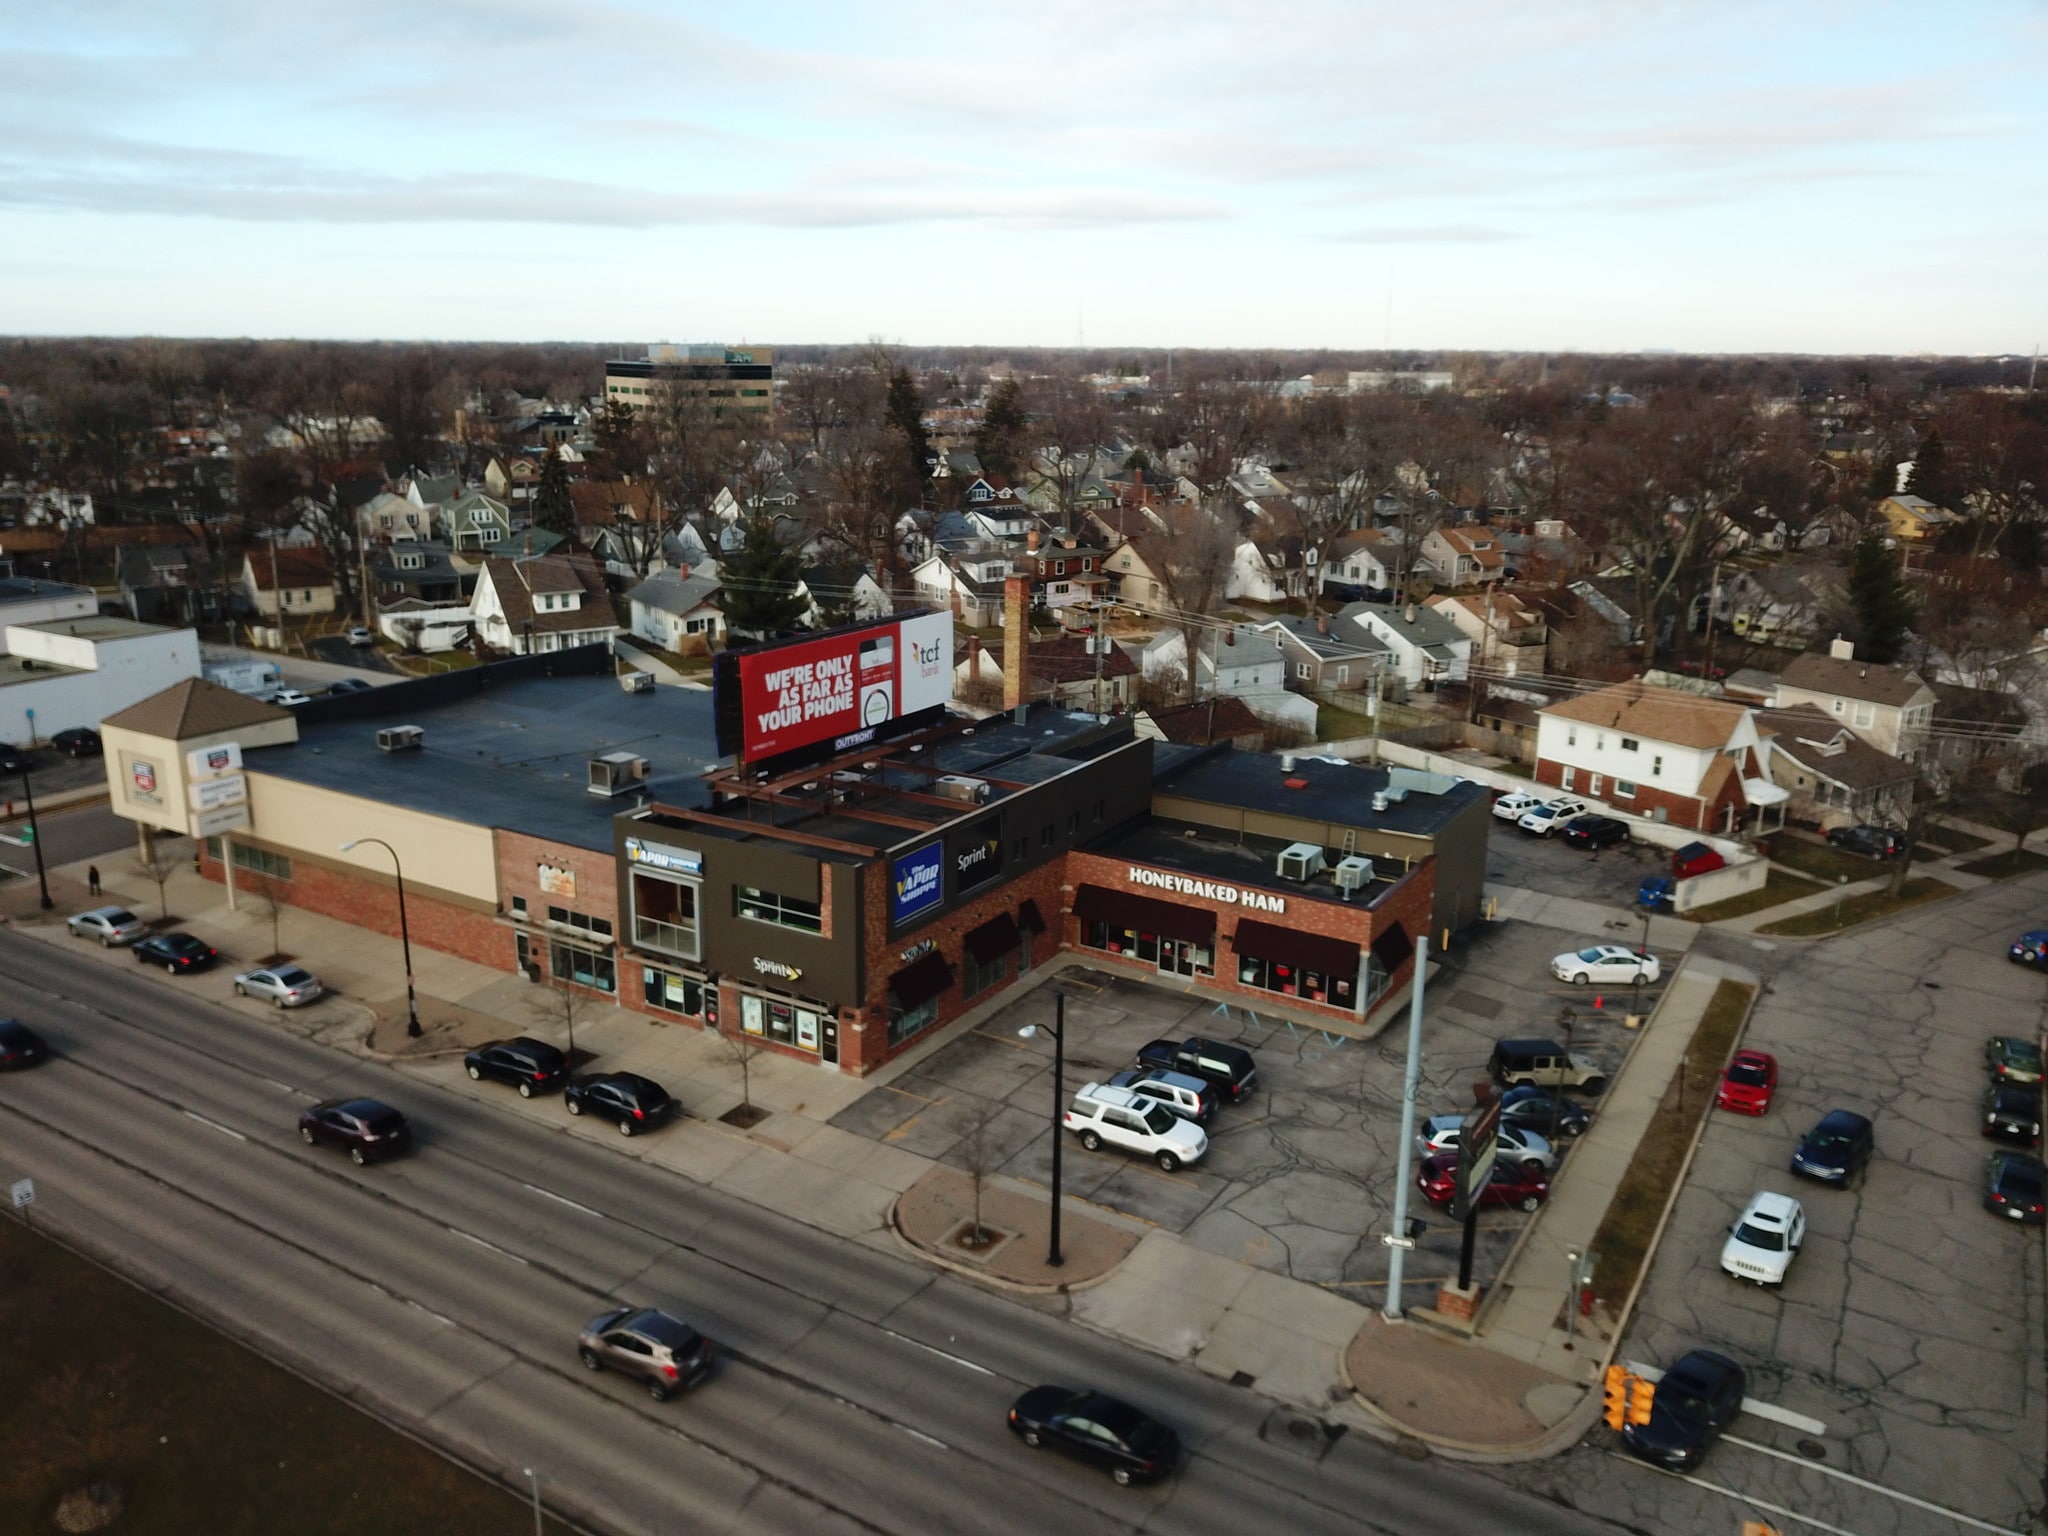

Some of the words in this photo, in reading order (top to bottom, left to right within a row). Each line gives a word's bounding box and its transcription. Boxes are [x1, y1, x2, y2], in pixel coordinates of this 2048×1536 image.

[920, 637, 940, 664] tcf
[765, 663, 813, 692] WE'RE
[816, 654, 853, 680] ONLY
[778, 686, 800, 709] AS
[803, 679, 831, 702] FAR
[833, 673, 853, 694] AS
[758, 705, 802, 733] YOUR
[804, 691, 854, 721] PHONE
[958, 845, 986, 871] Sprint
[897, 864, 939, 897] VAPOR
[1129, 867, 1238, 903] HONEYBAKED
[1241, 891, 1285, 913] HAM
[753, 957, 787, 977] Sprint
